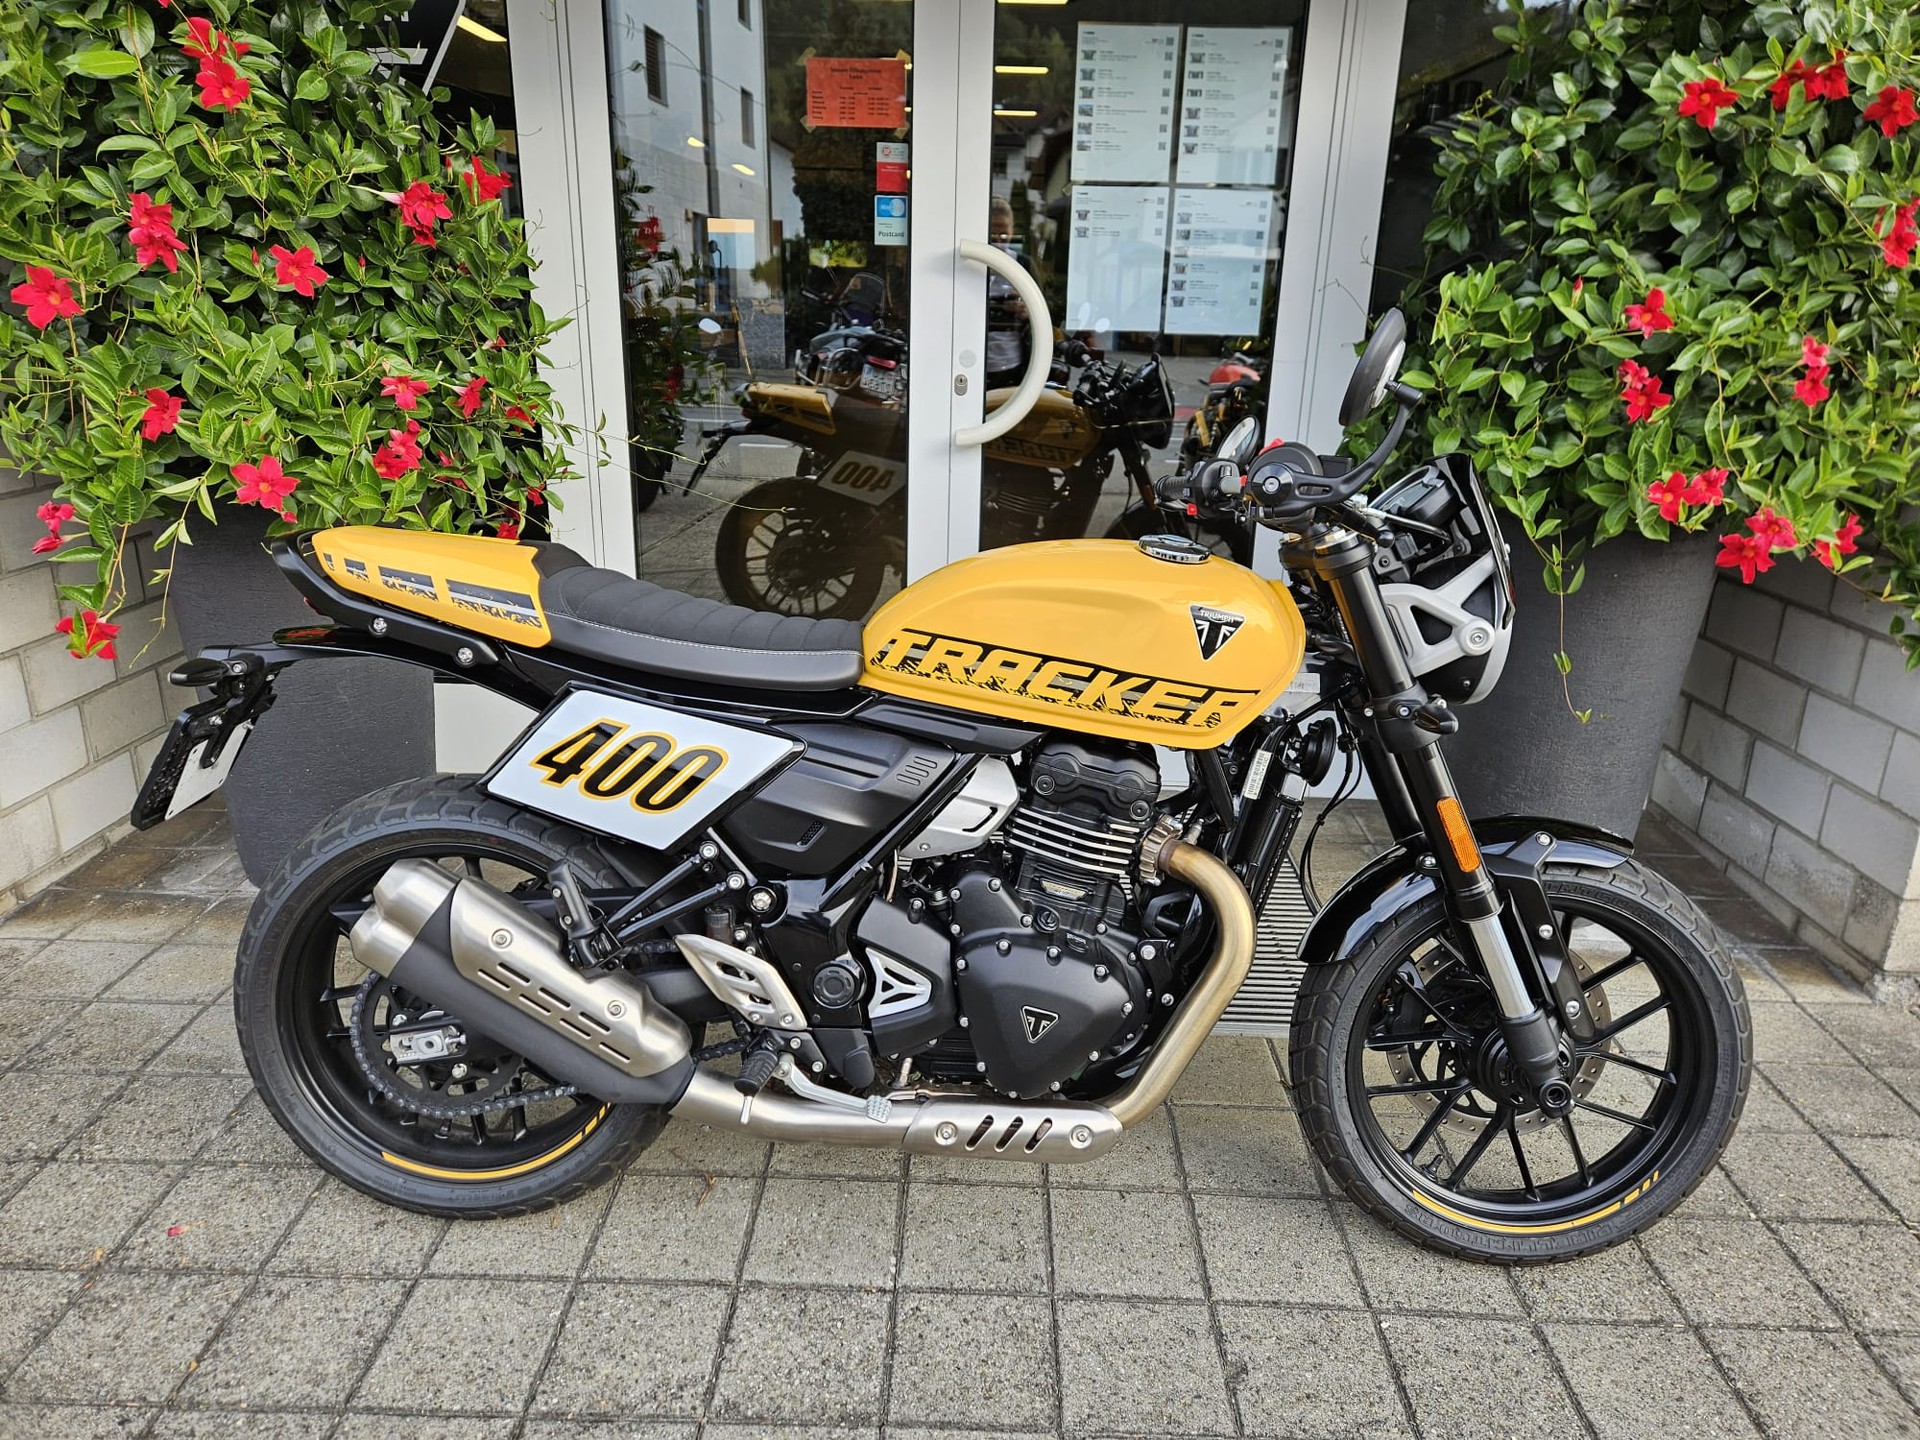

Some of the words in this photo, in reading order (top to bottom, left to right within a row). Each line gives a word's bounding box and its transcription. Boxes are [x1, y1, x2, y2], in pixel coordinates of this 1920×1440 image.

[1200, 609, 1235, 623] TRIUMPH
[872, 629, 1260, 729] TRACKER
[528, 717, 729, 814] 400
